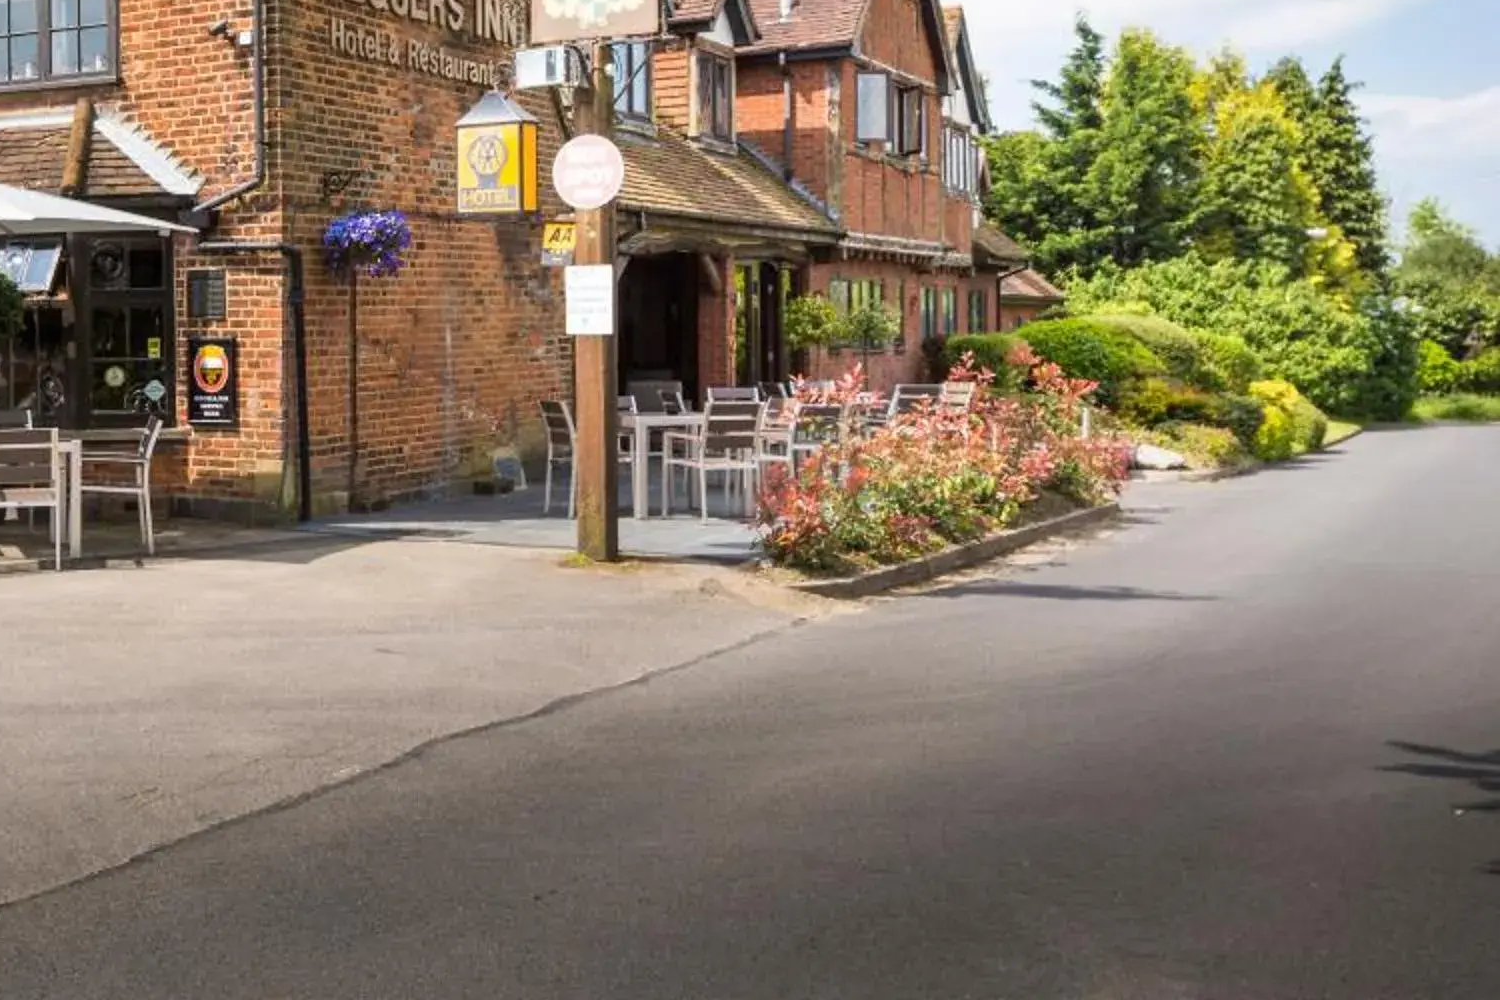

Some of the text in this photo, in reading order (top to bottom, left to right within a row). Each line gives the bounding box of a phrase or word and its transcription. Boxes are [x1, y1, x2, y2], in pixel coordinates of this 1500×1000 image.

[330, 17, 496, 85] Hotel & Restaurant
[462, 189, 514, 207] HOTEL
[548, 227, 573, 243] AA
